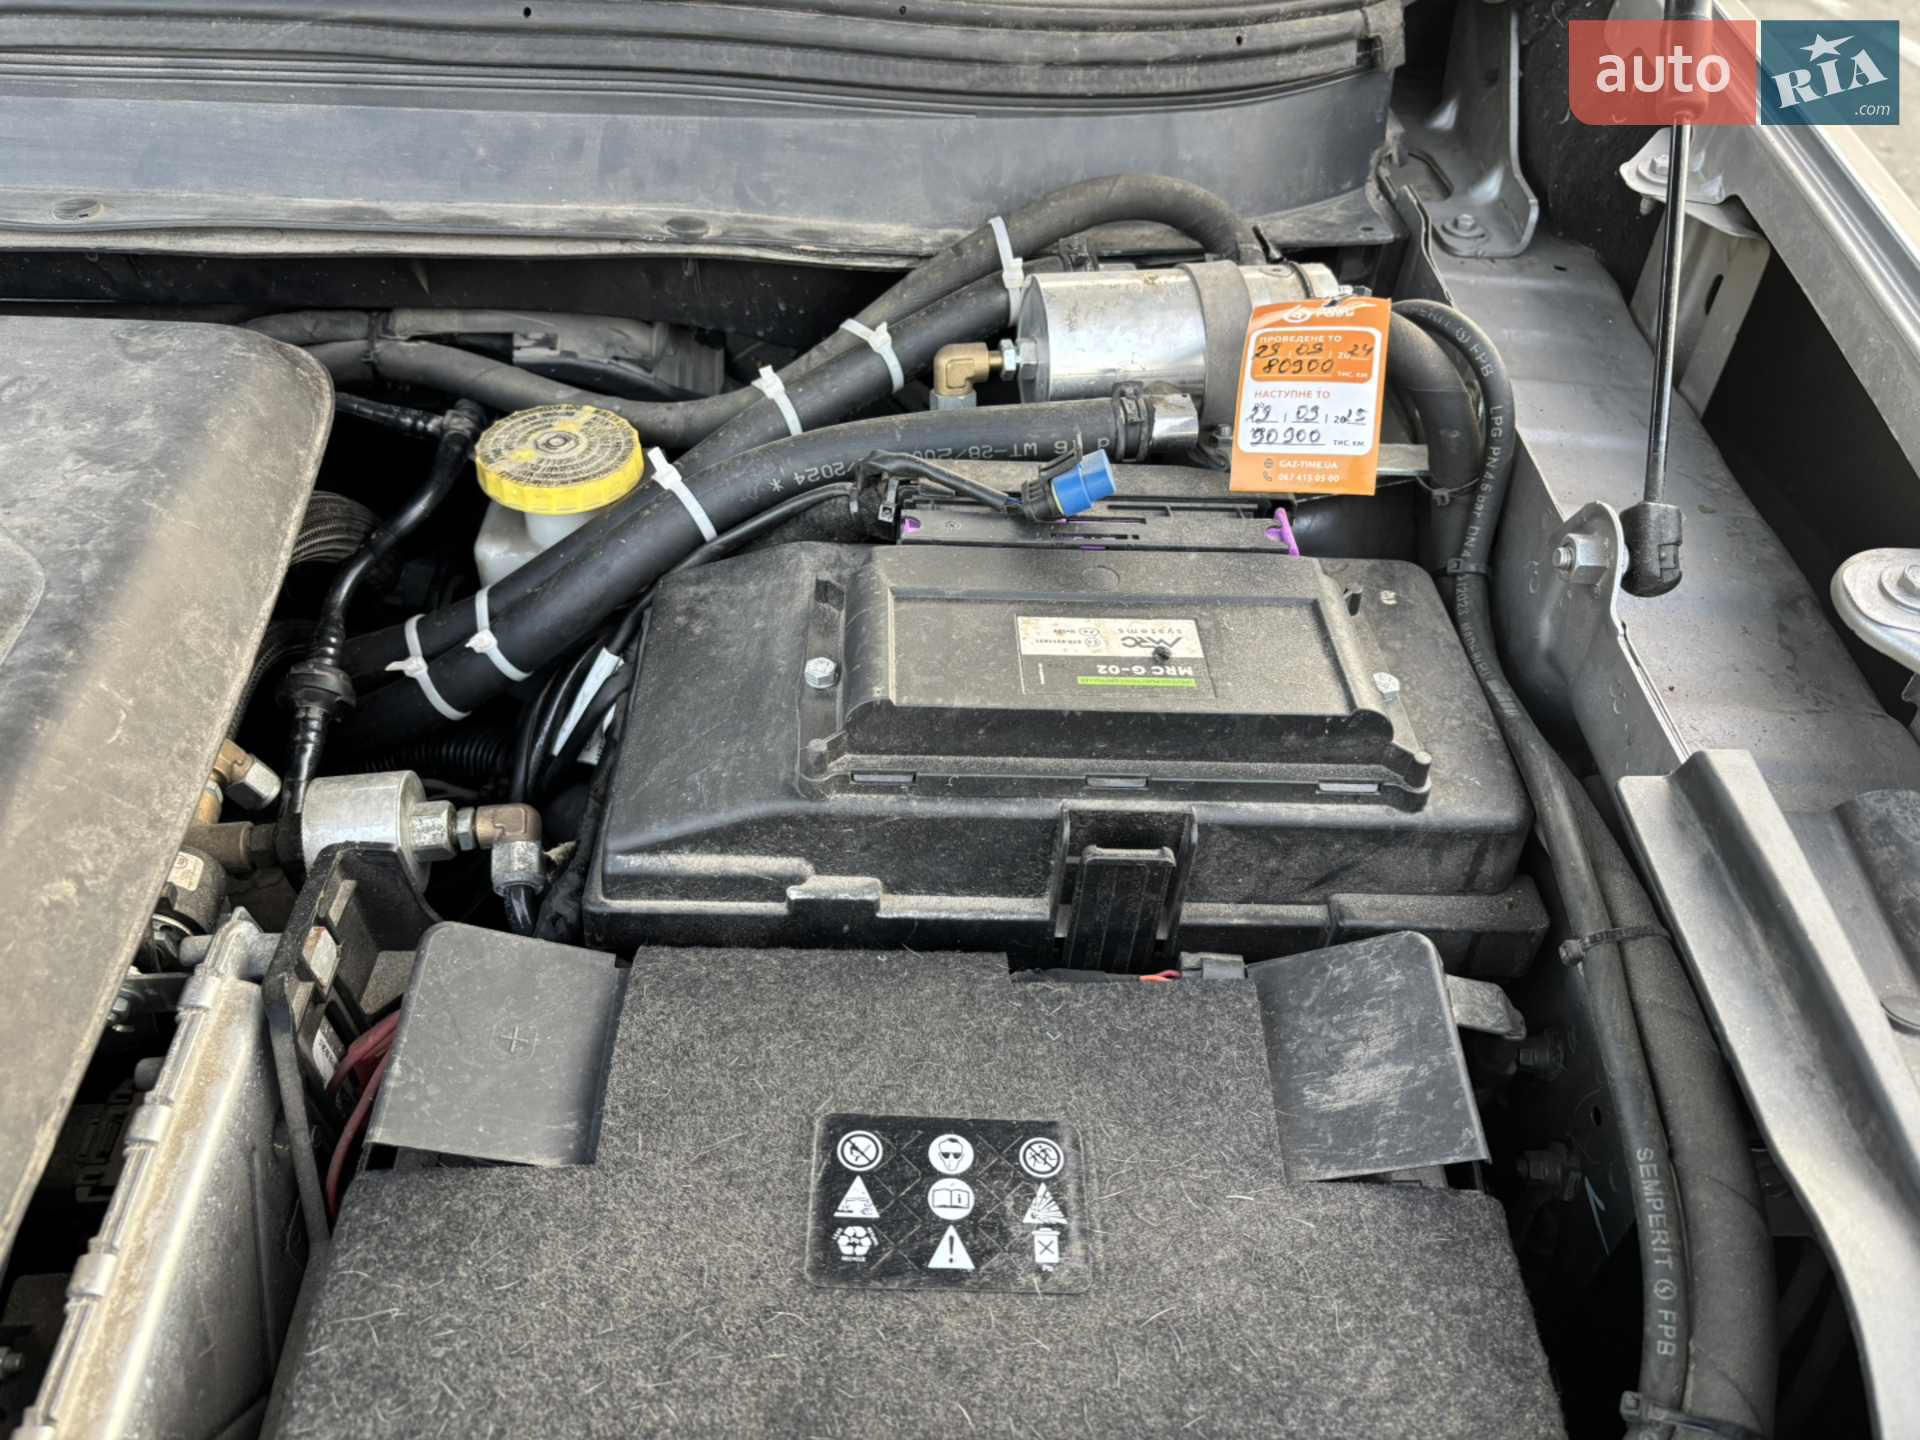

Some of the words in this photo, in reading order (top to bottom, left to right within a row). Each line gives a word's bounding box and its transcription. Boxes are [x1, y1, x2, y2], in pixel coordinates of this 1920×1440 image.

[1259, 335, 1325, 343] ПРОВЕДЕНЕ
[1254, 390, 1313, 399] НАСТУПНЕ
[1316, 390, 1331, 399] ТО
[1489, 404, 1503, 438] LPG
[1485, 445, 1501, 469] PN
[1279, 460, 1339, 469] GAZ-TIME.UA
[1278, 473, 1294, 481] 067
[1297, 474, 1313, 482] 415
[1314, 475, 1326, 483] 05
[1327, 475, 1340, 483] 00
[1472, 496, 1488, 518] bar
[1463, 525, 1481, 548] DN
[1096, 665, 1146, 675] G-02
[1151, 665, 1194, 676] MRC
[1636, 1147, 1673, 1269] SEMPERIT
[1656, 1309, 1677, 1357] FPB
